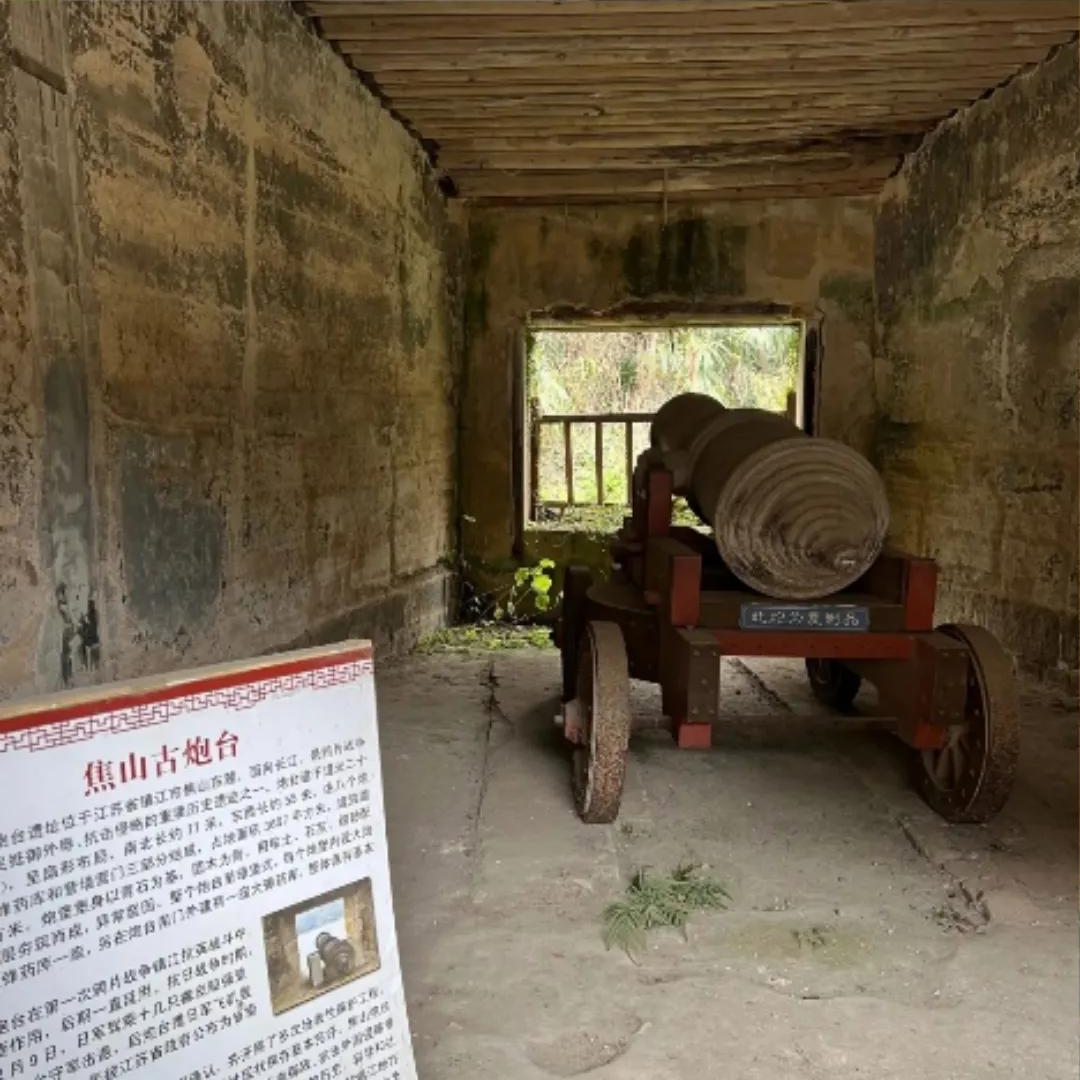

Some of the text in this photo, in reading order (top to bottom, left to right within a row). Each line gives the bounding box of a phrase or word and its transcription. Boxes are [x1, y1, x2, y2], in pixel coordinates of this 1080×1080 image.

[84, 732, 240, 797] 焦山古炮台
